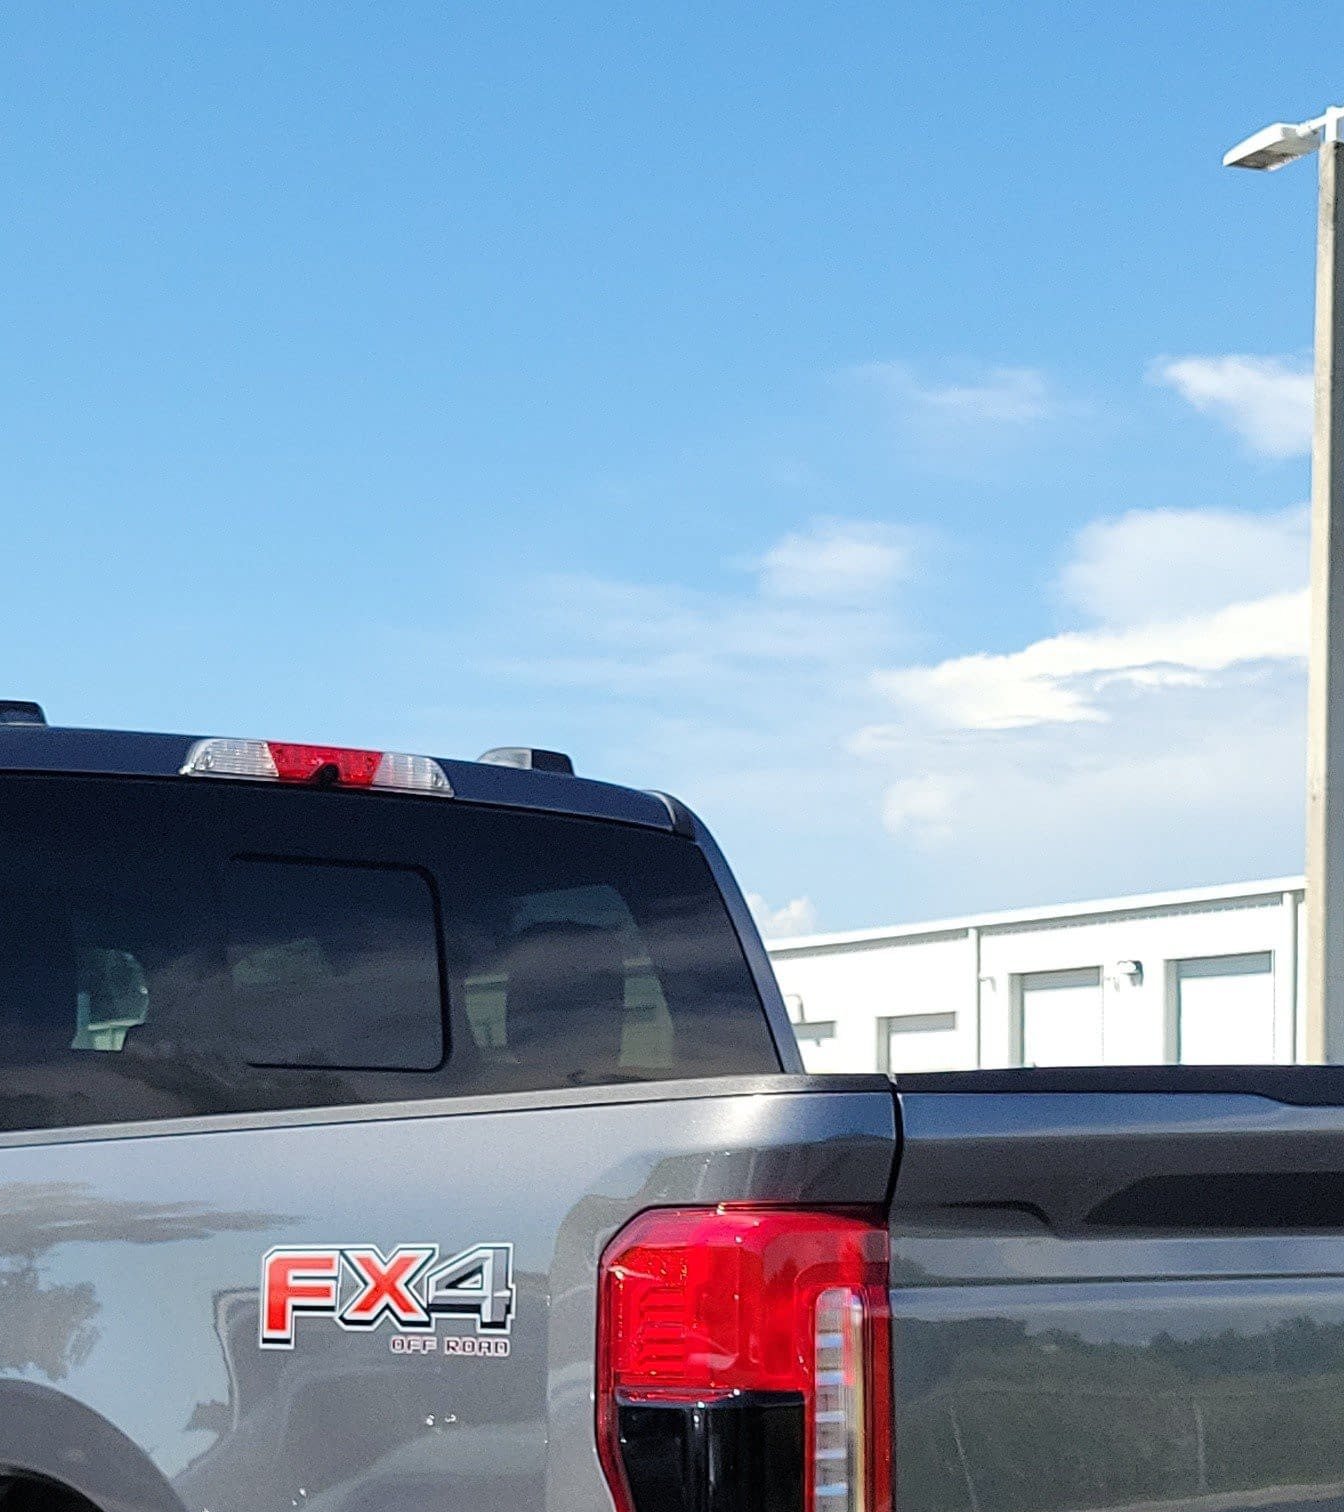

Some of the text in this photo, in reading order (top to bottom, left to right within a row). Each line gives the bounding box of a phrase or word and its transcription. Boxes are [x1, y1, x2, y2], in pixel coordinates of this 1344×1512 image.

[260, 1243, 515, 1349] FX4
[390, 1335, 511, 1357] OFF ROAD
